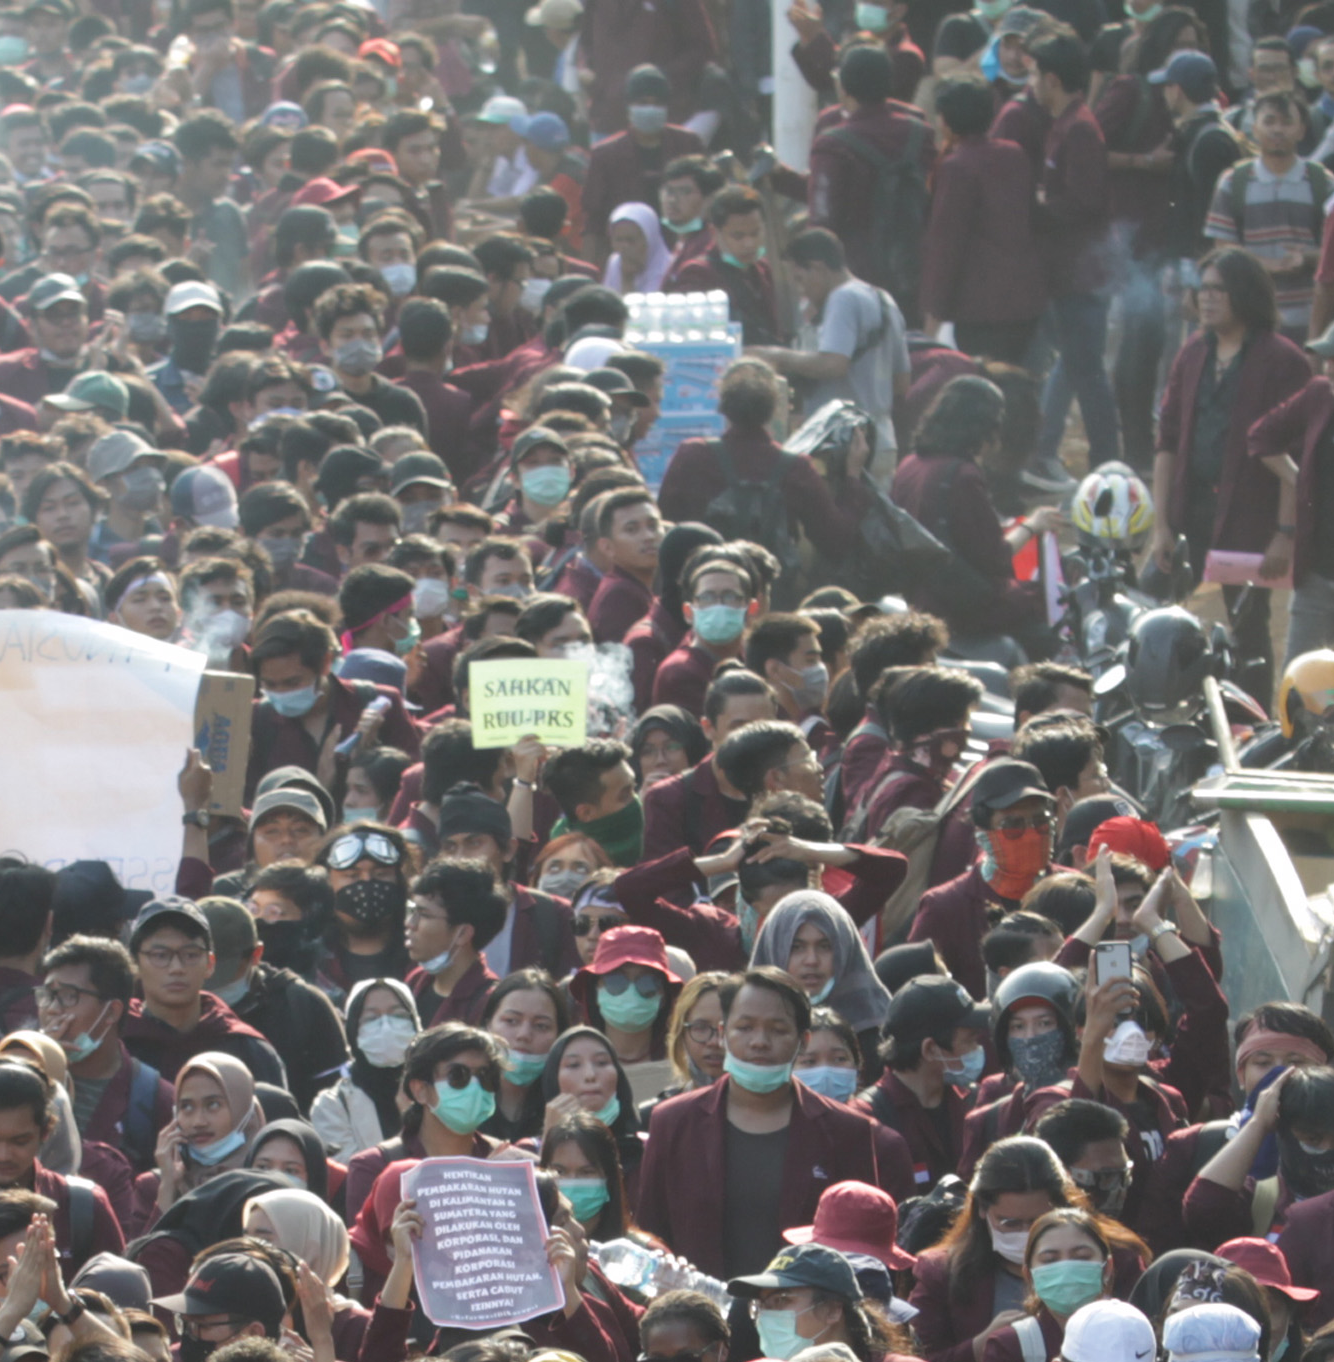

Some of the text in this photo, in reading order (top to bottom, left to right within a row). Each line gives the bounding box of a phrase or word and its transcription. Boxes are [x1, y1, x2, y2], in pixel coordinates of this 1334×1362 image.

[484, 677, 572, 698] SAHKAN
[483, 708, 574, 730] RUU-PKS
[443, 1170, 492, 1182] HENTIKAN
[417, 1182, 522, 1197] PEMBAKARAN HUTAN
[429, 1198, 441, 1209] DI
[442, 1195, 505, 1207] KALIMANTAN
[433, 1207, 516, 1222] SUMATERA YANG
[434, 1220, 520, 1236] DILAKUKAN OLEH
[502, 1235, 523, 1245] DAN
[453, 1247, 513, 1261] PIDANAKAN
[454, 1259, 516, 1275] KORPORASI
[431, 1272, 504, 1290] PEMBAKARAN
[455, 1284, 524, 1301] SERTA CABUT
